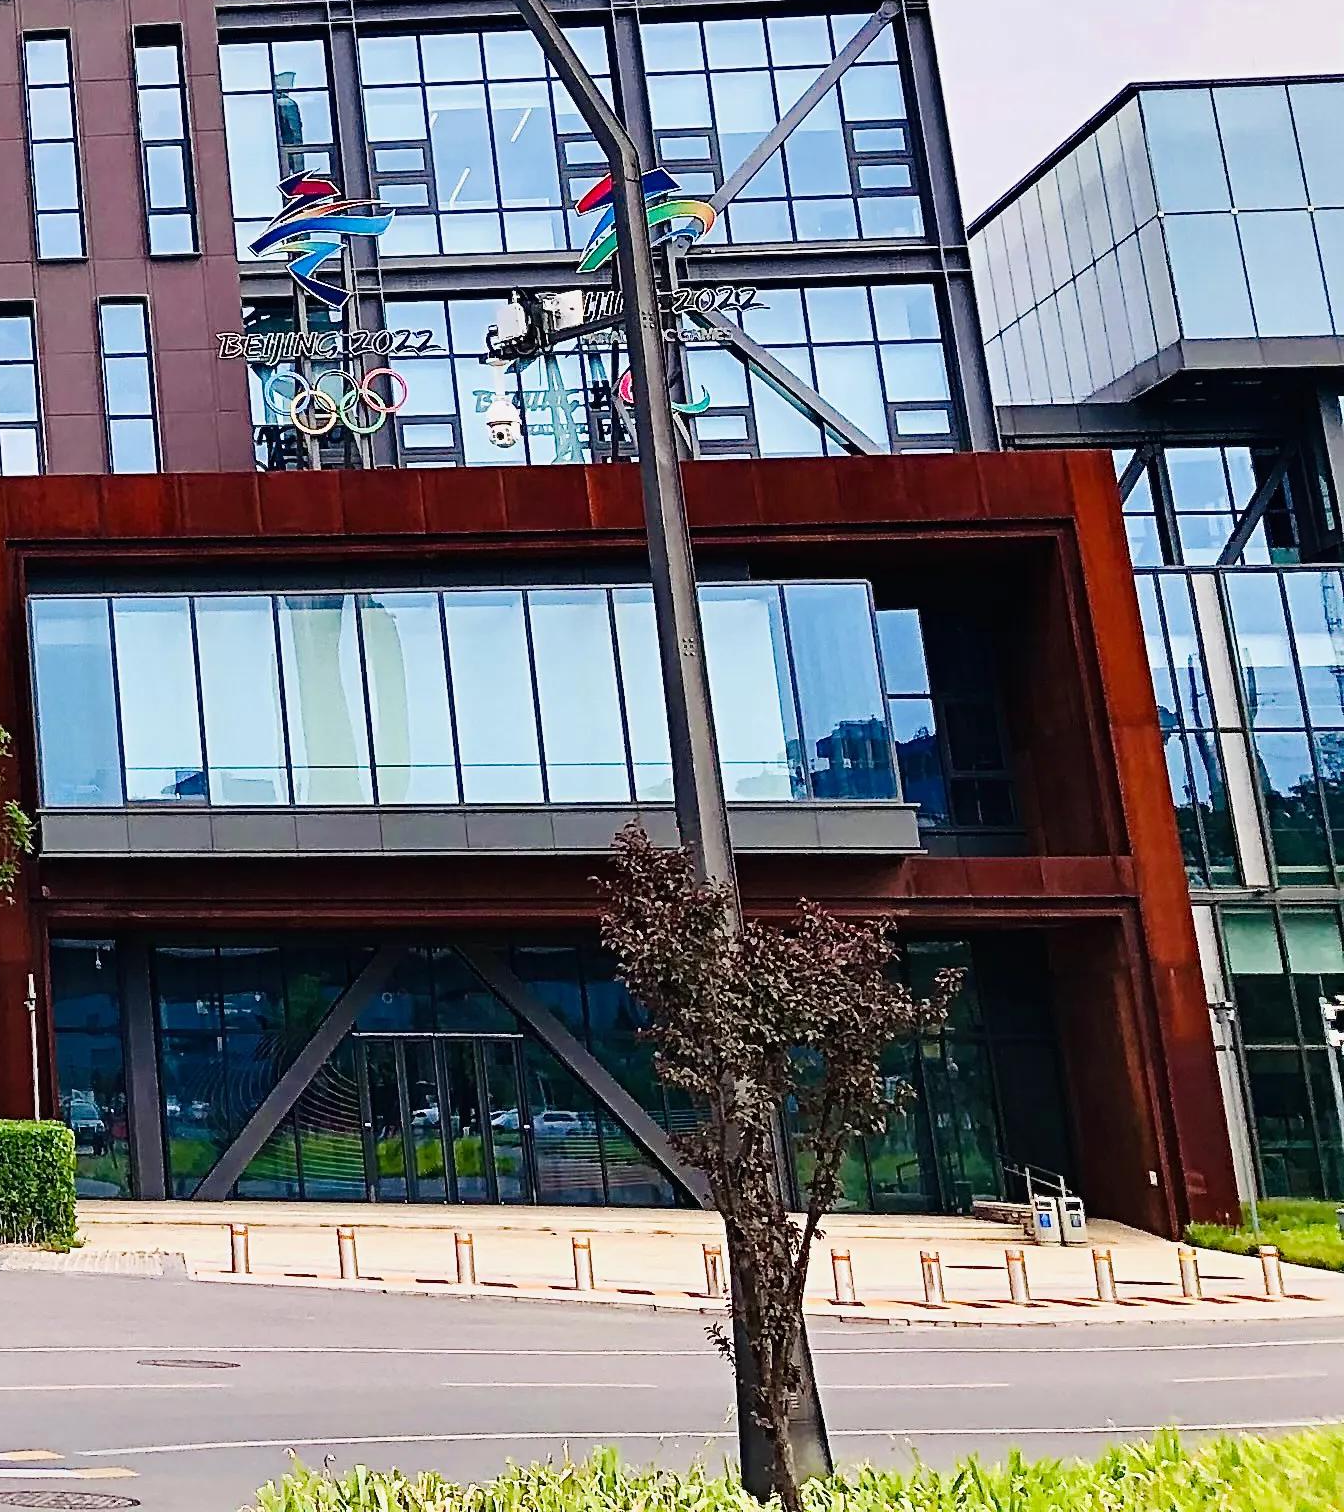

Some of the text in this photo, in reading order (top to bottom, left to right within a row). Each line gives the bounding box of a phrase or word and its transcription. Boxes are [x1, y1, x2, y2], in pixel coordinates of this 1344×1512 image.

[672, 286, 770, 314] 2022
[216, 329, 446, 366] BEIJING 2022
[678, 328, 733, 342] GAMES
